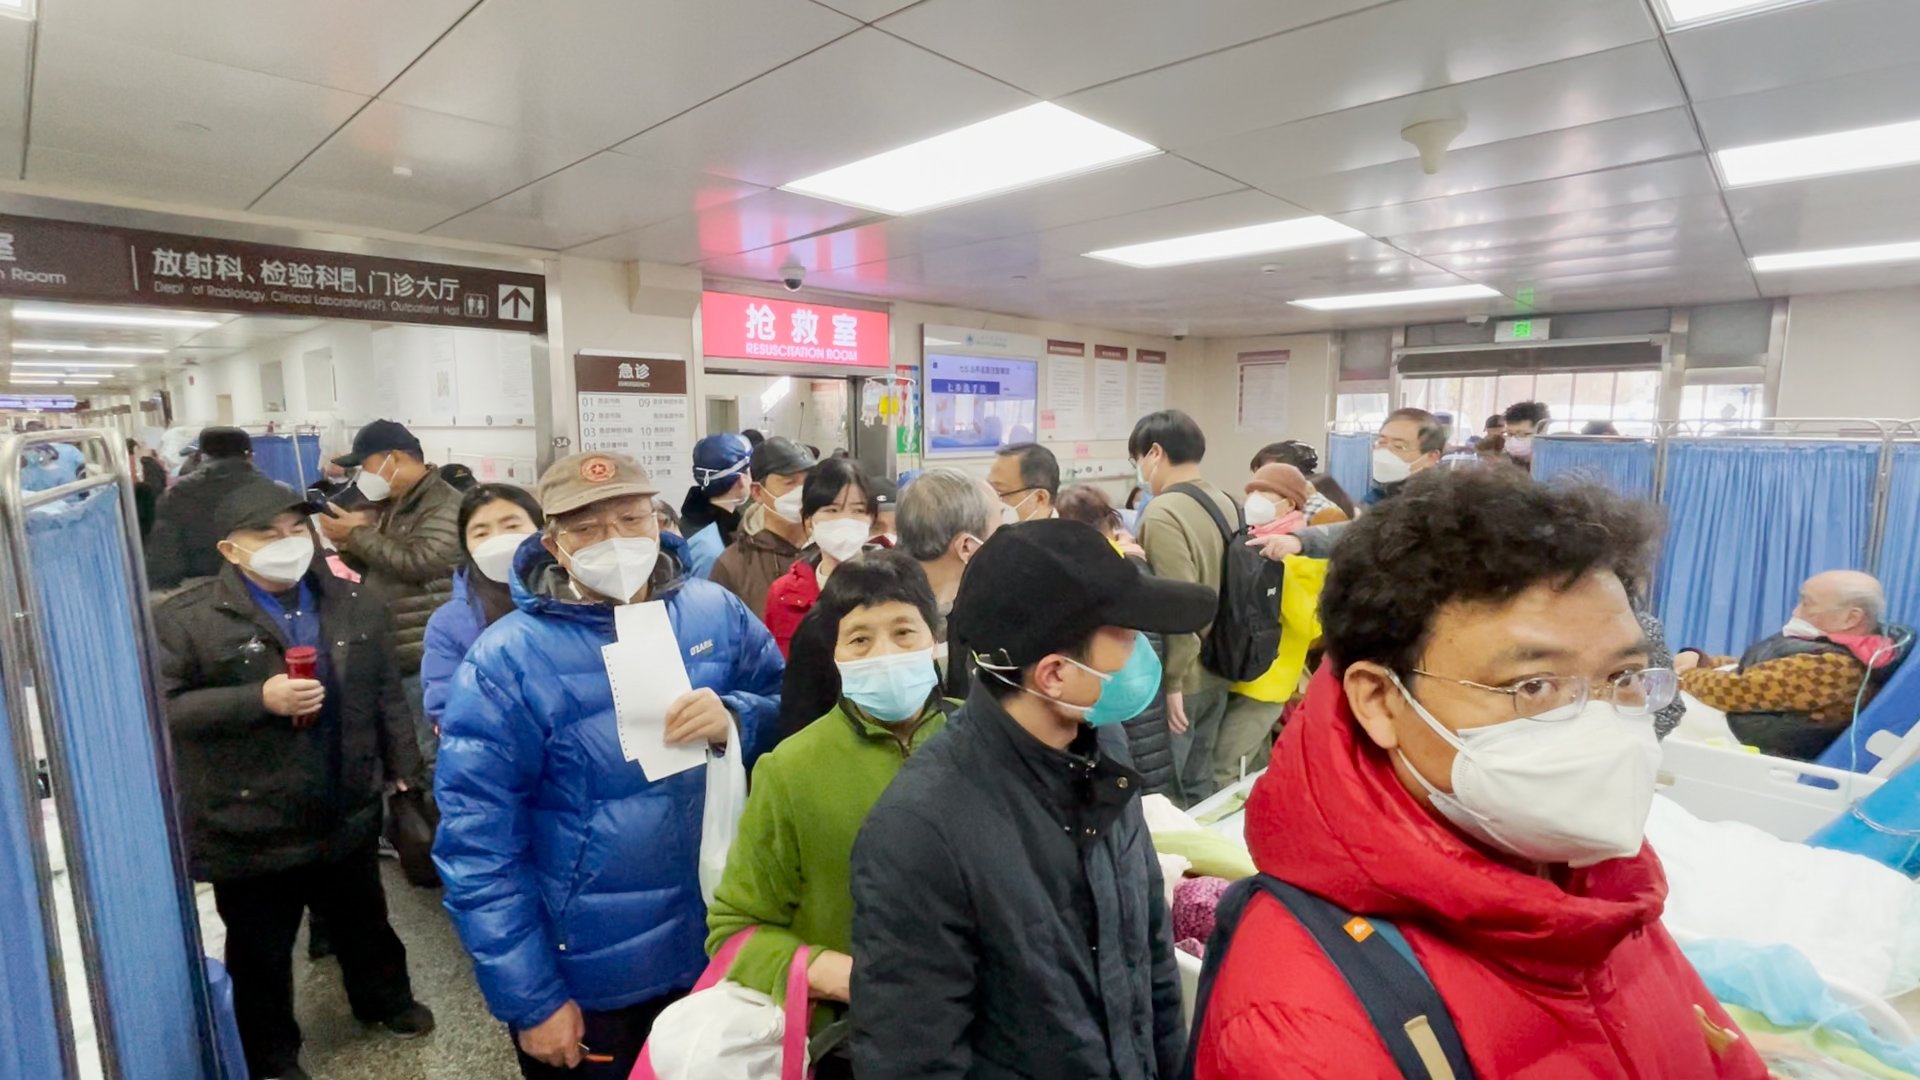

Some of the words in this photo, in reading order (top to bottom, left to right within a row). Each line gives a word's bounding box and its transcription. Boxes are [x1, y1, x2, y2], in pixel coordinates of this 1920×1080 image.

[11, 268, 67, 285] Room
[192, 284, 203, 295] of
[271, 290, 312, 304] Clinical
[390, 300, 439, 314] Outpatient
[443, 305, 460, 316] Hall
[745, 302, 858, 348] 抢救室
[745, 342, 825, 359] RESUSCITATION
[826, 349, 858, 362] ROOM
[618, 362, 650, 379] 急诊
[582, 397, 593, 407] 01
[639, 398, 650, 408] 09
[583, 412, 595, 422] 02
[583, 427, 596, 437] 03
[640, 426, 652, 436] 10
[641, 441, 652, 450] 11
[642, 455, 653, 465] 12
